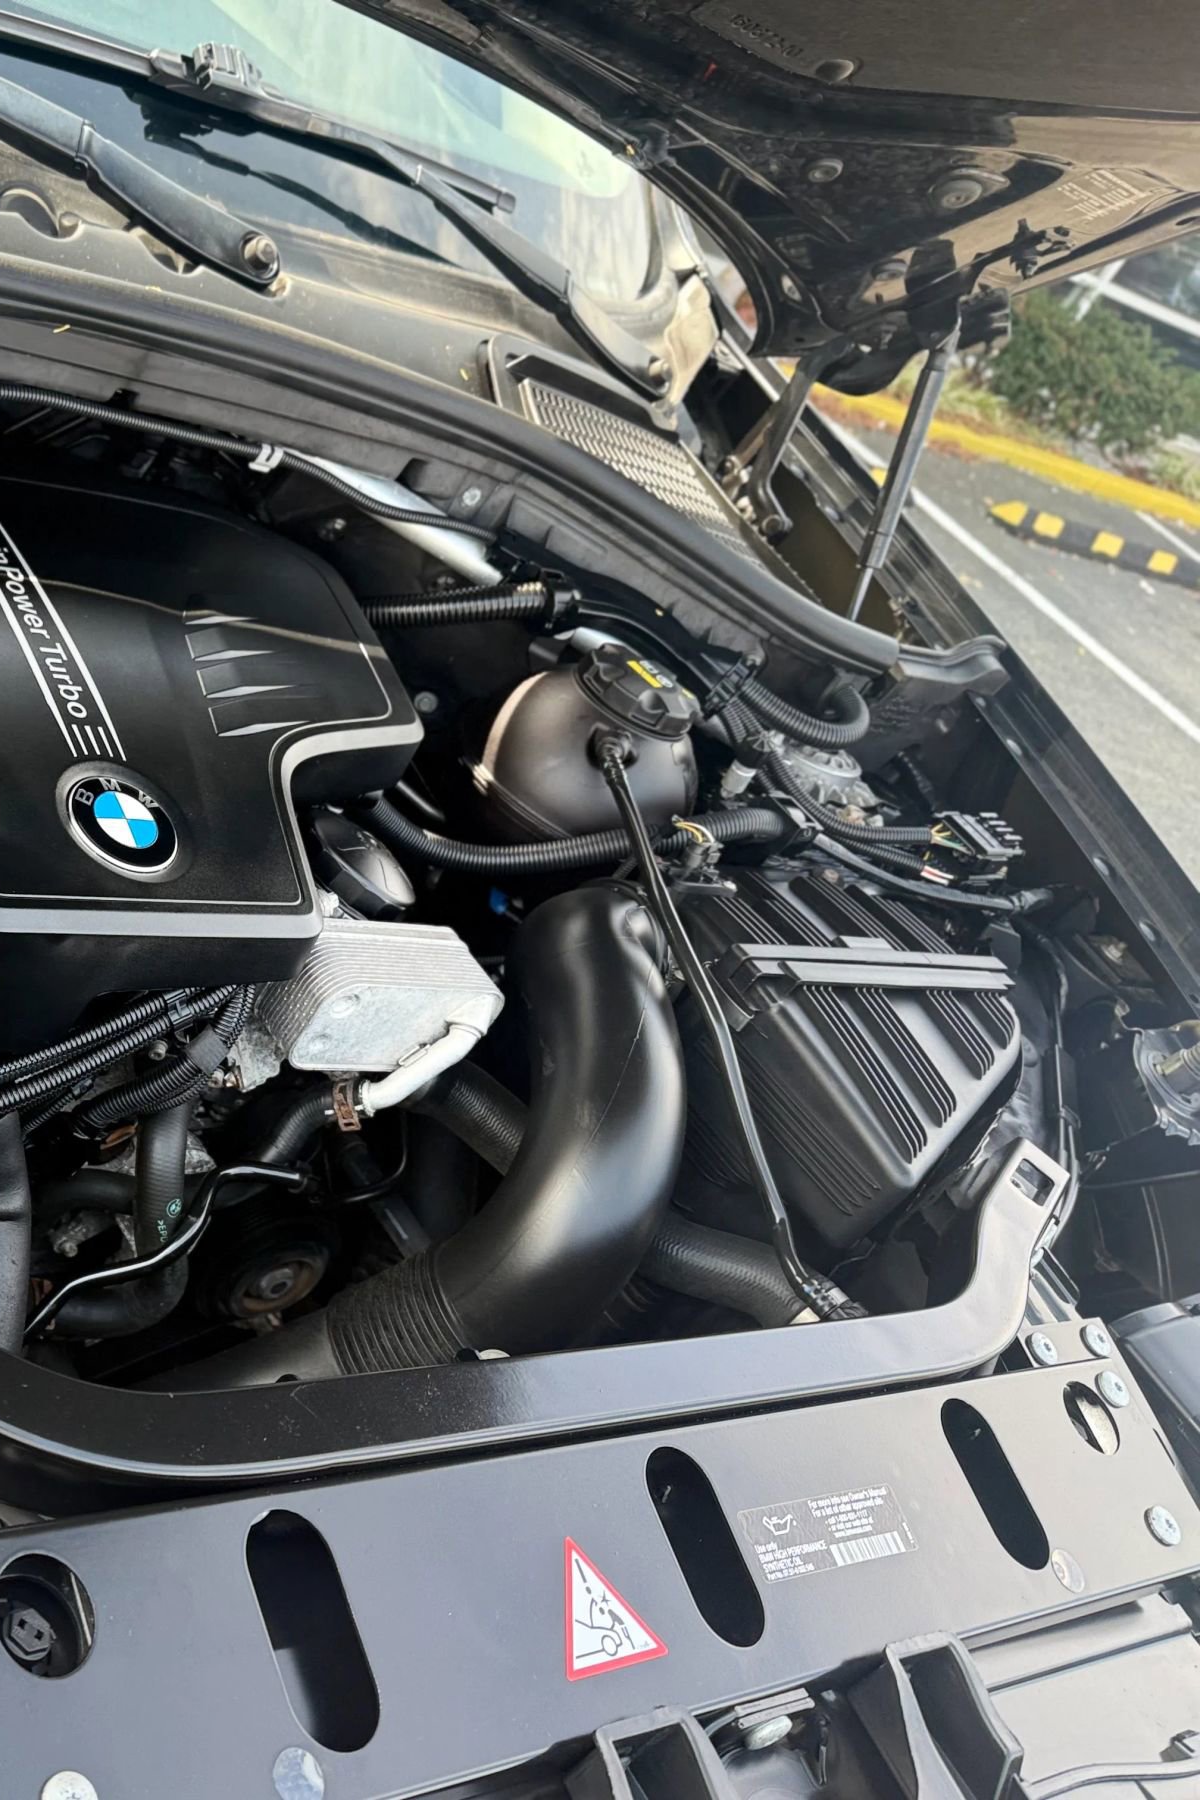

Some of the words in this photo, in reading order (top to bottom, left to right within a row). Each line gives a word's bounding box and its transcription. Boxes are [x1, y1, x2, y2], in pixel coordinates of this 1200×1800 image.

[39, 643, 88, 719] Turbo
[75, 778, 160, 807] BMW
[786, 1540, 828, 1556] PERFORMANCE
[762, 1558, 794, 1572] SYNTHETIC
